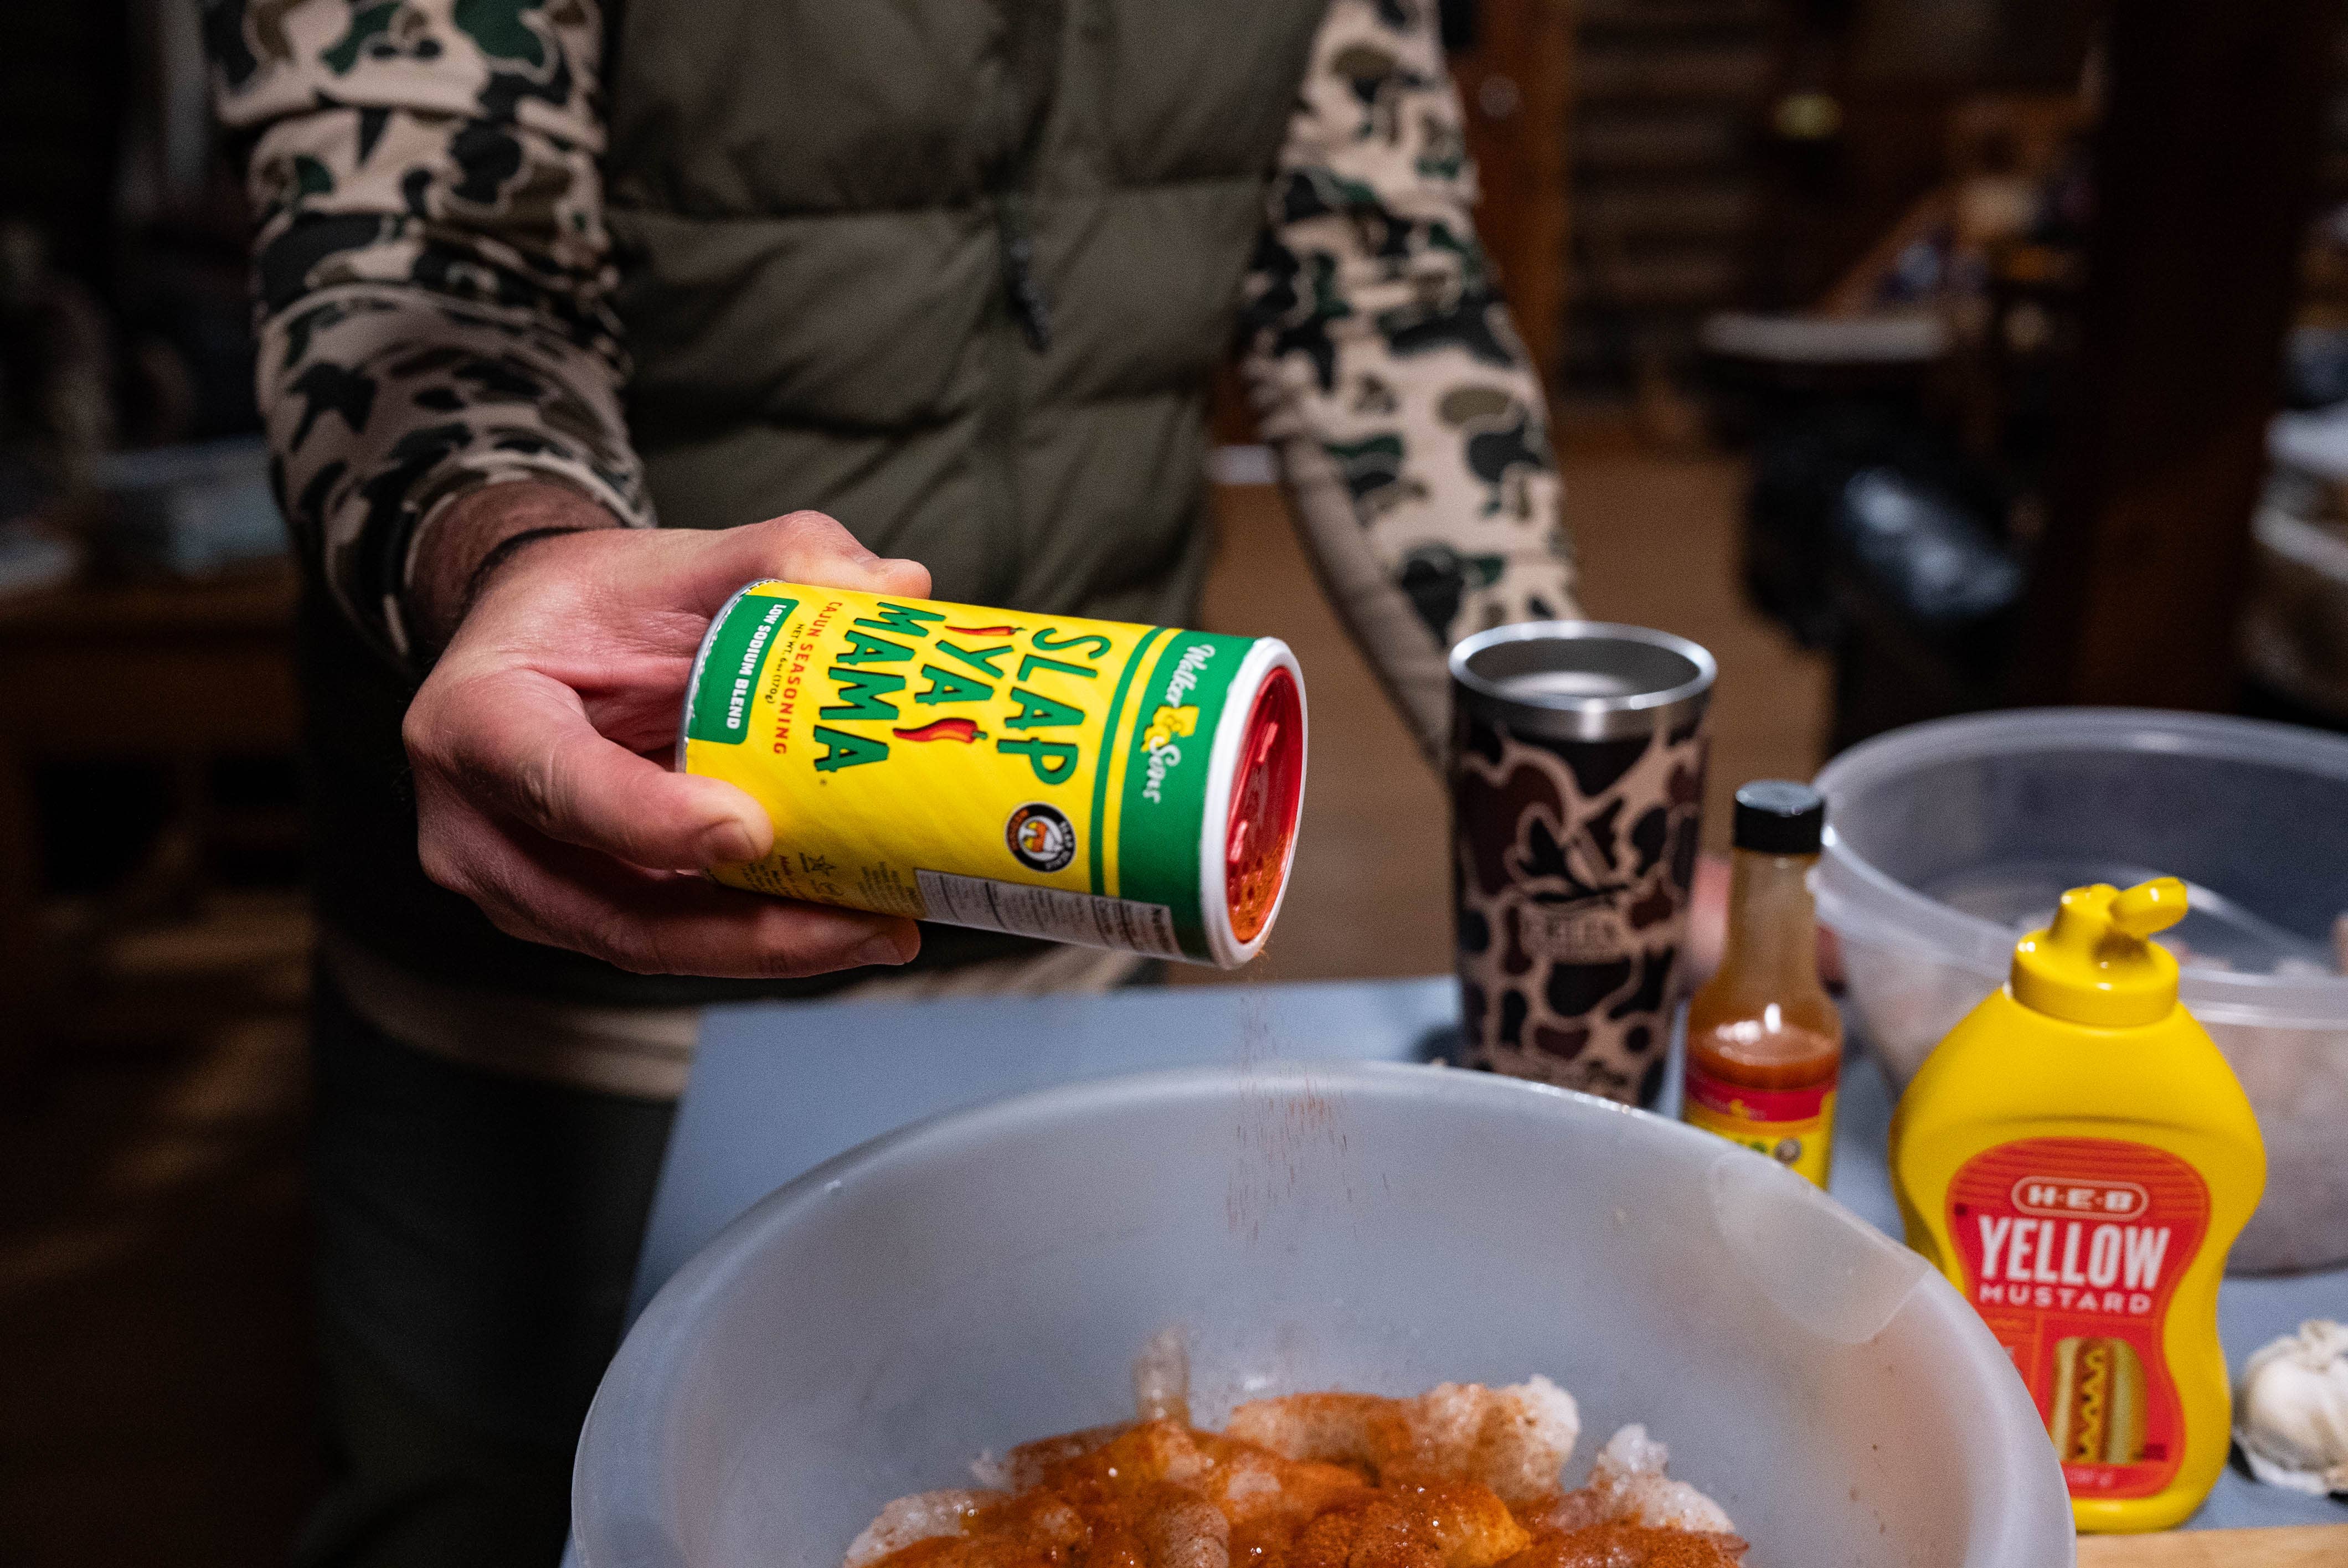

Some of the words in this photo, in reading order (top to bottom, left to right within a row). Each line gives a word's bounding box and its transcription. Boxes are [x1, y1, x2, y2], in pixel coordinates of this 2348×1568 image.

[763, 604, 787, 625] LOW
[791, 623, 805, 638] NET
[806, 602, 843, 637] CAJUN
[739, 625, 771, 675] SODIUM
[914, 639, 1013, 705] YA
[1165, 644, 1216, 708] Walker
[727, 678, 750, 729] BLEND
[765, 674, 782, 704] (170g)
[773, 643, 813, 755] SEASONING
[813, 602, 946, 772] MAMA
[997, 627, 1111, 785] SLAP
[1142, 736, 1181, 803] Sons
[1979, 1215, 2171, 1291] YELLOW
[1979, 1283, 2151, 1314] MUSTARD
